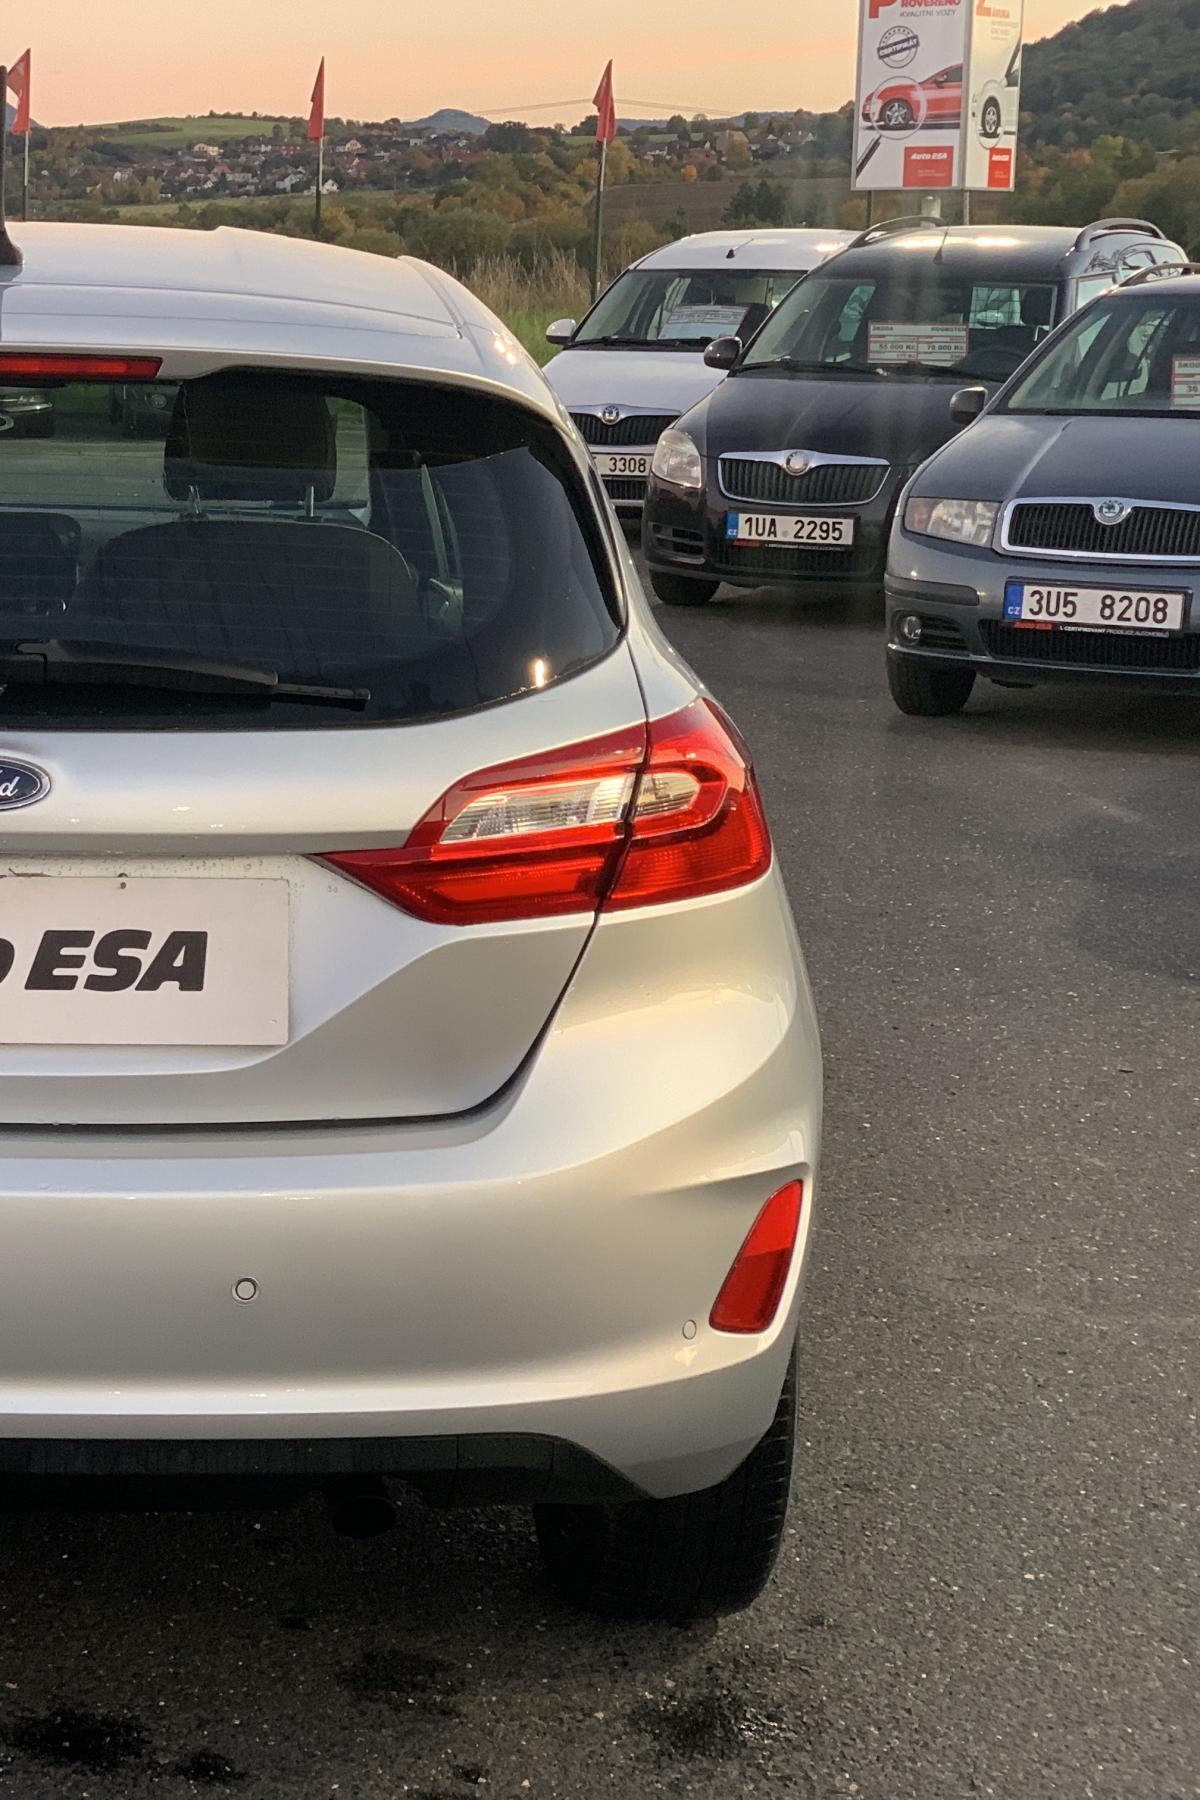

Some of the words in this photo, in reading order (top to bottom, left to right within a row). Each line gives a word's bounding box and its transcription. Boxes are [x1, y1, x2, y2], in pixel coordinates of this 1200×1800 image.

[608, 456, 647, 474] 3308
[727, 528, 738, 536] CZ
[744, 517, 778, 538] 1UA
[792, 519, 844, 541] 2295
[1007, 605, 1021, 615] CZ
[1028, 590, 1079, 618] 3U5
[1099, 594, 1169, 624] 8208
[23, 928, 209, 993] ESA
